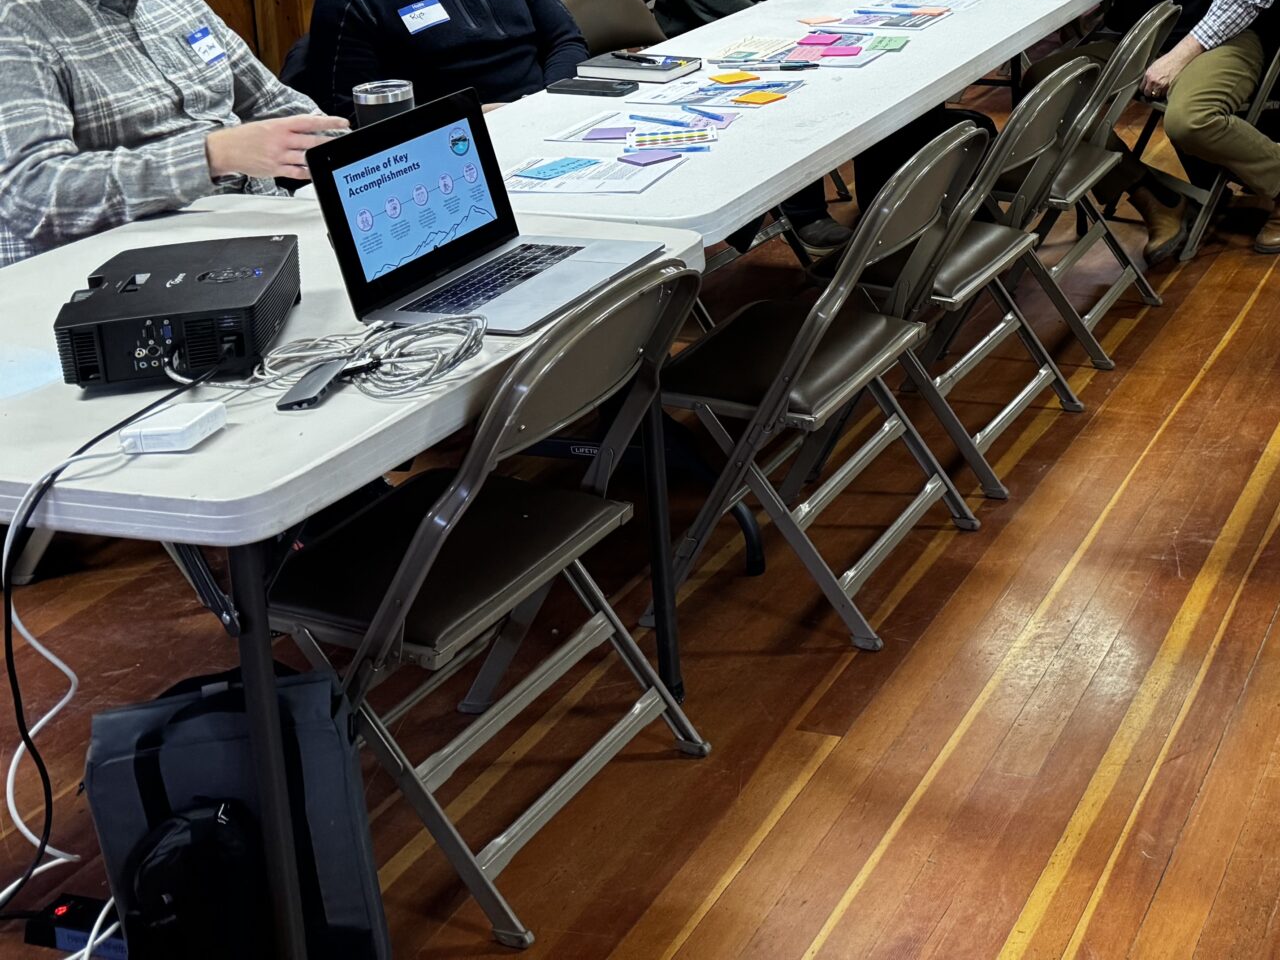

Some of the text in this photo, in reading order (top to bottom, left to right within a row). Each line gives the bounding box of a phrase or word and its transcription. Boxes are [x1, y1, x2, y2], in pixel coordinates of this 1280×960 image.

[343, 152, 409, 185] Timeline of Key
[348, 161, 421, 198] Accomplishments
